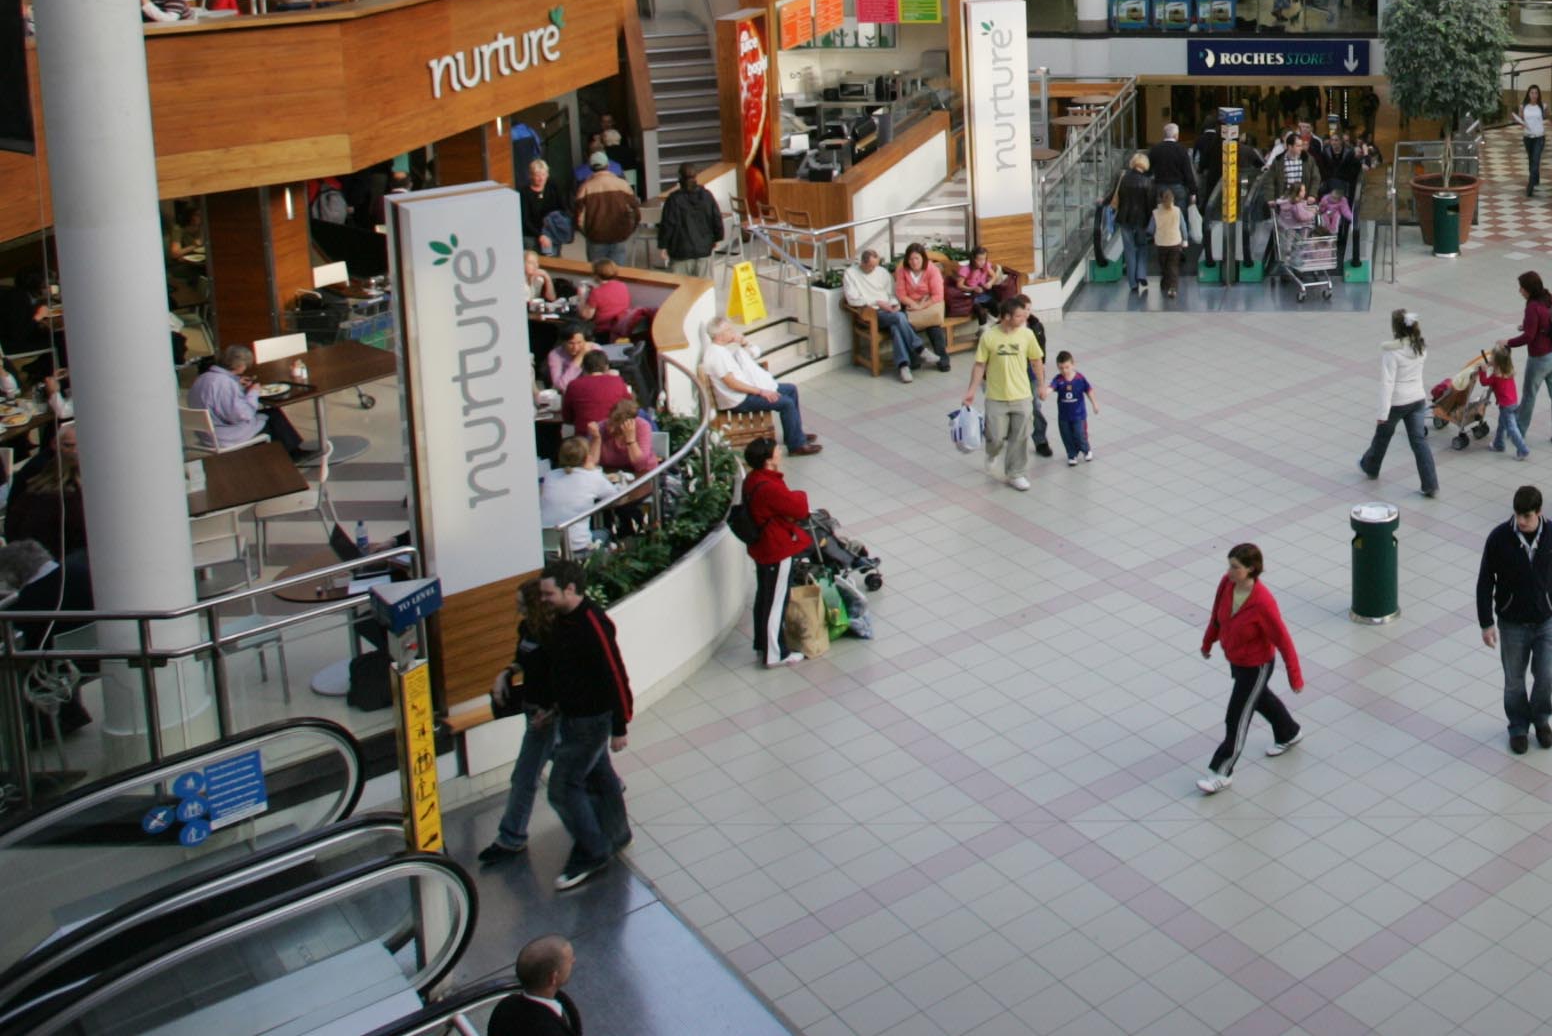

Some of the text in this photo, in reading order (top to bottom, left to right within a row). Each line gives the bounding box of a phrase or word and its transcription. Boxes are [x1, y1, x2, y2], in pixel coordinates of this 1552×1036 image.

[428, 24, 560, 99] nurture
[1219, 51, 1336, 65] ROCHES STORES
[989, 28, 1017, 172] nurture
[451, 246, 510, 510] nurture
[398, 585, 435, 612] TO LEVEL
